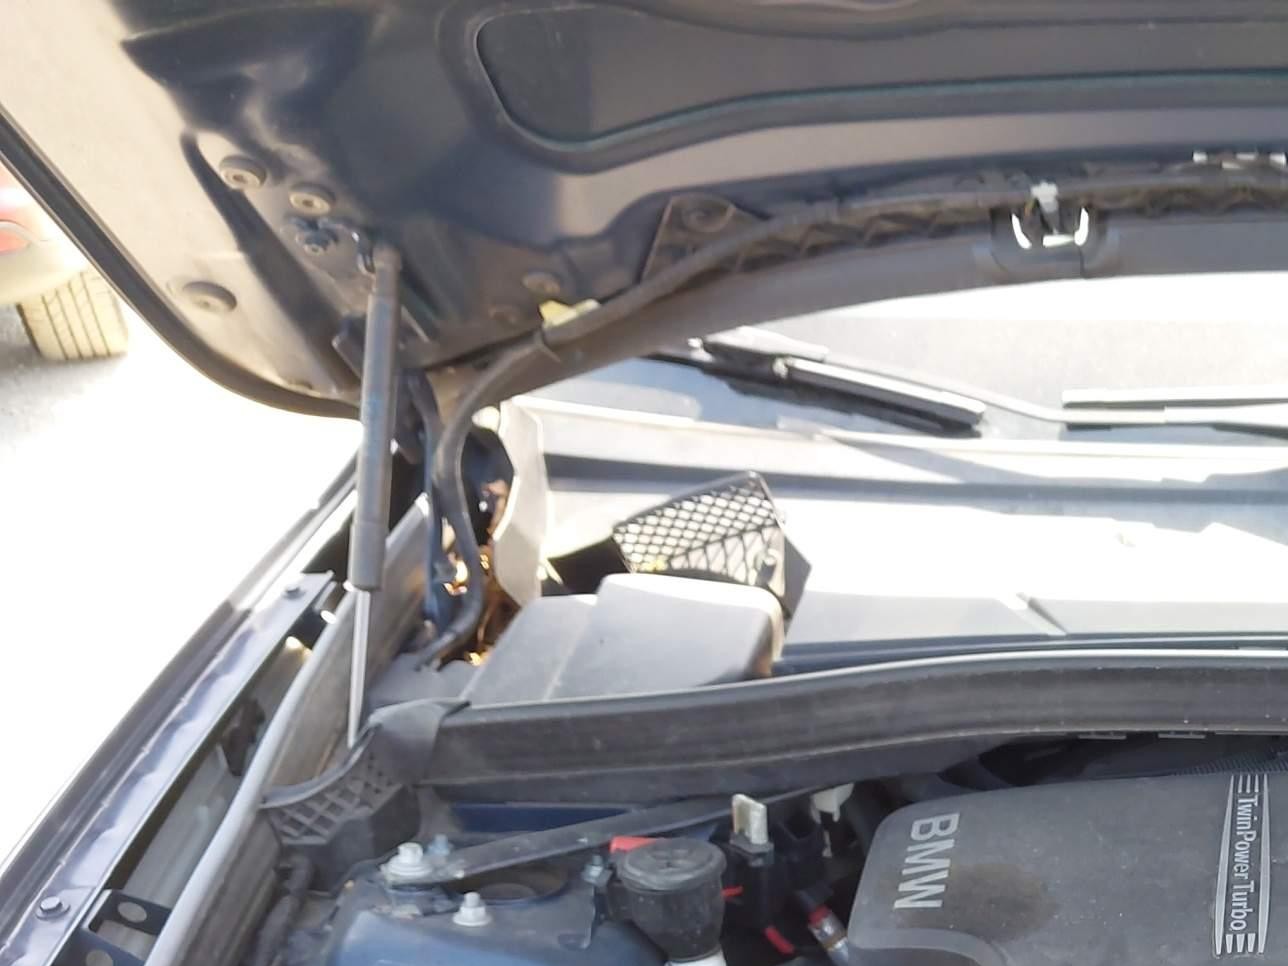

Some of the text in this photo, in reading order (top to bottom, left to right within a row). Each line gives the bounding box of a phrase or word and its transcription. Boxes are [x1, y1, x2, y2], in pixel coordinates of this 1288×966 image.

[893, 812, 960, 909] BMW
[1229, 796, 1258, 931] TwinPower Turbo
